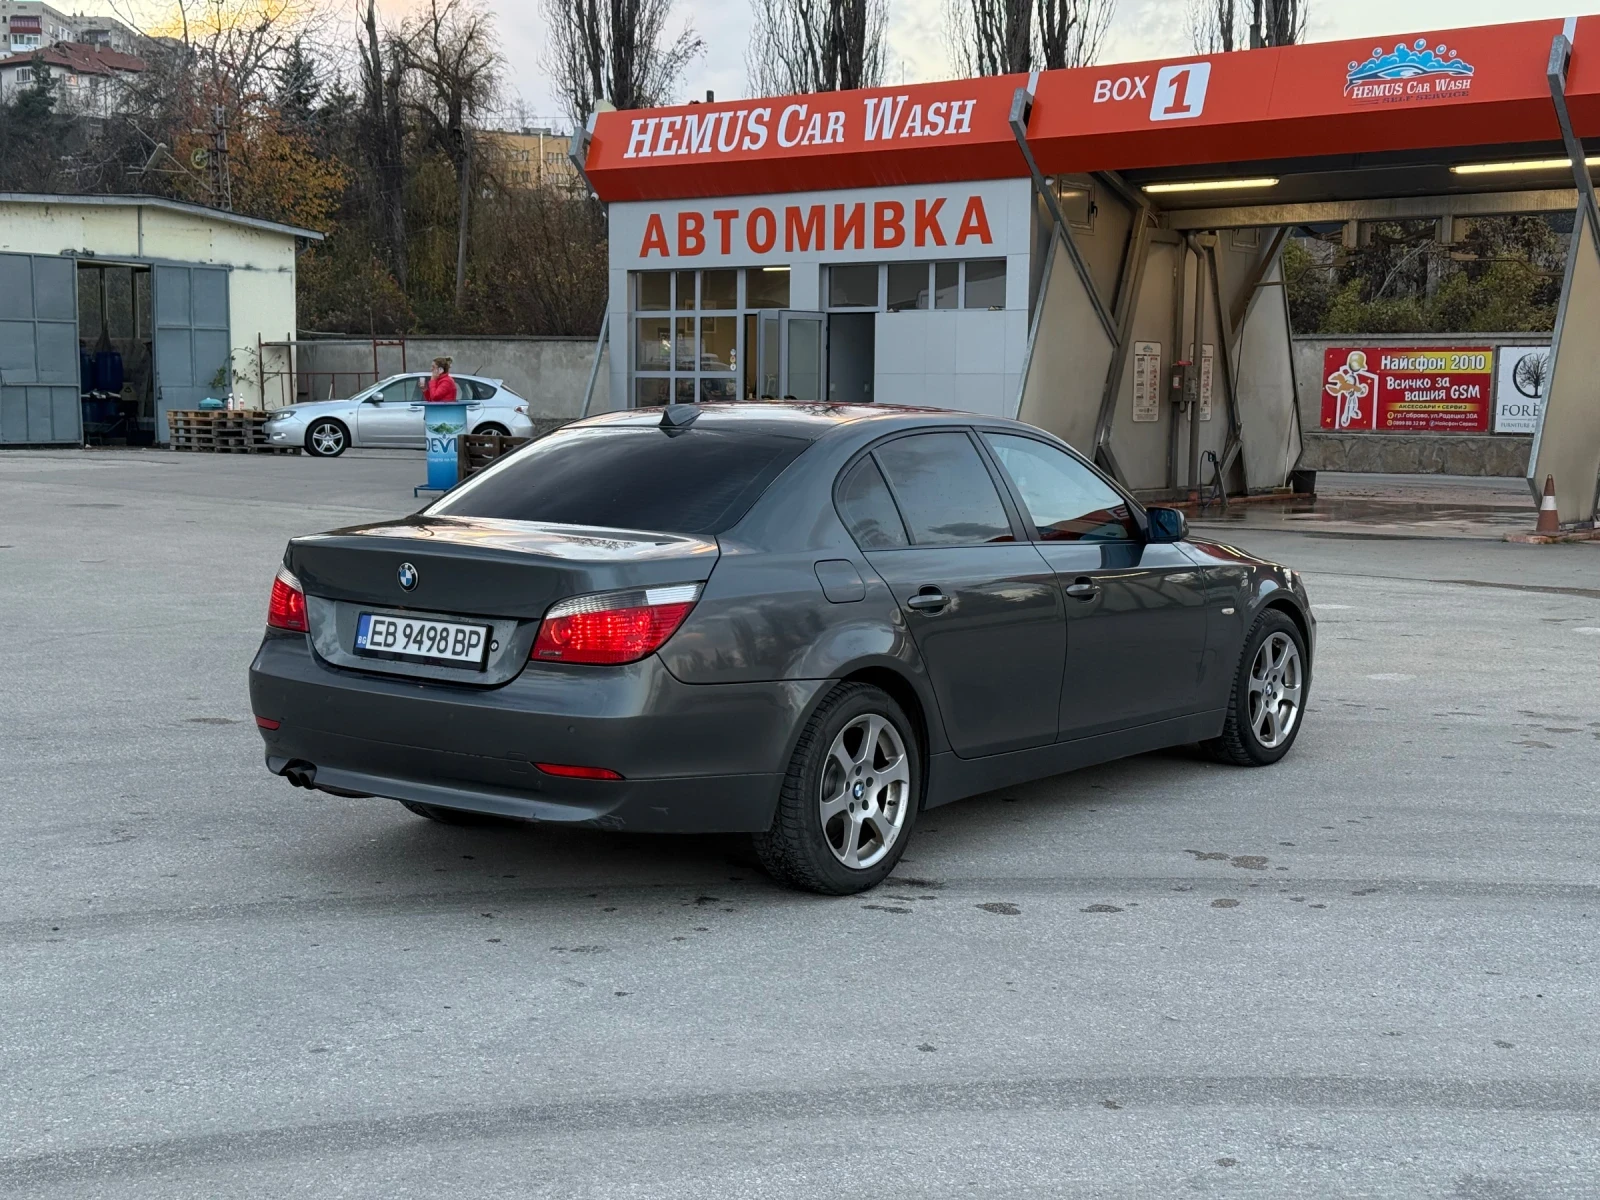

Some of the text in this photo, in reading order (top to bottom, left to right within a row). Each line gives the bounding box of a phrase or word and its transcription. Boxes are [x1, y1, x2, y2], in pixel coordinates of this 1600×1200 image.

[1093, 70, 1191, 115] BOX 1
[1352, 83, 1403, 99] HEMUS
[1382, 91, 1469, 104] SELF SERVICE
[624, 106, 772, 159] HEMUS
[639, 196, 993, 258] АВТОМИВКА
[1381, 354, 1486, 373] Найсфон 2010
[1386, 376, 1450, 390] Всичко за
[1404, 385, 1480, 401] вашия GSM
[357, 635, 367, 645] BG
[370, 619, 481, 657] EB 9498 BP
